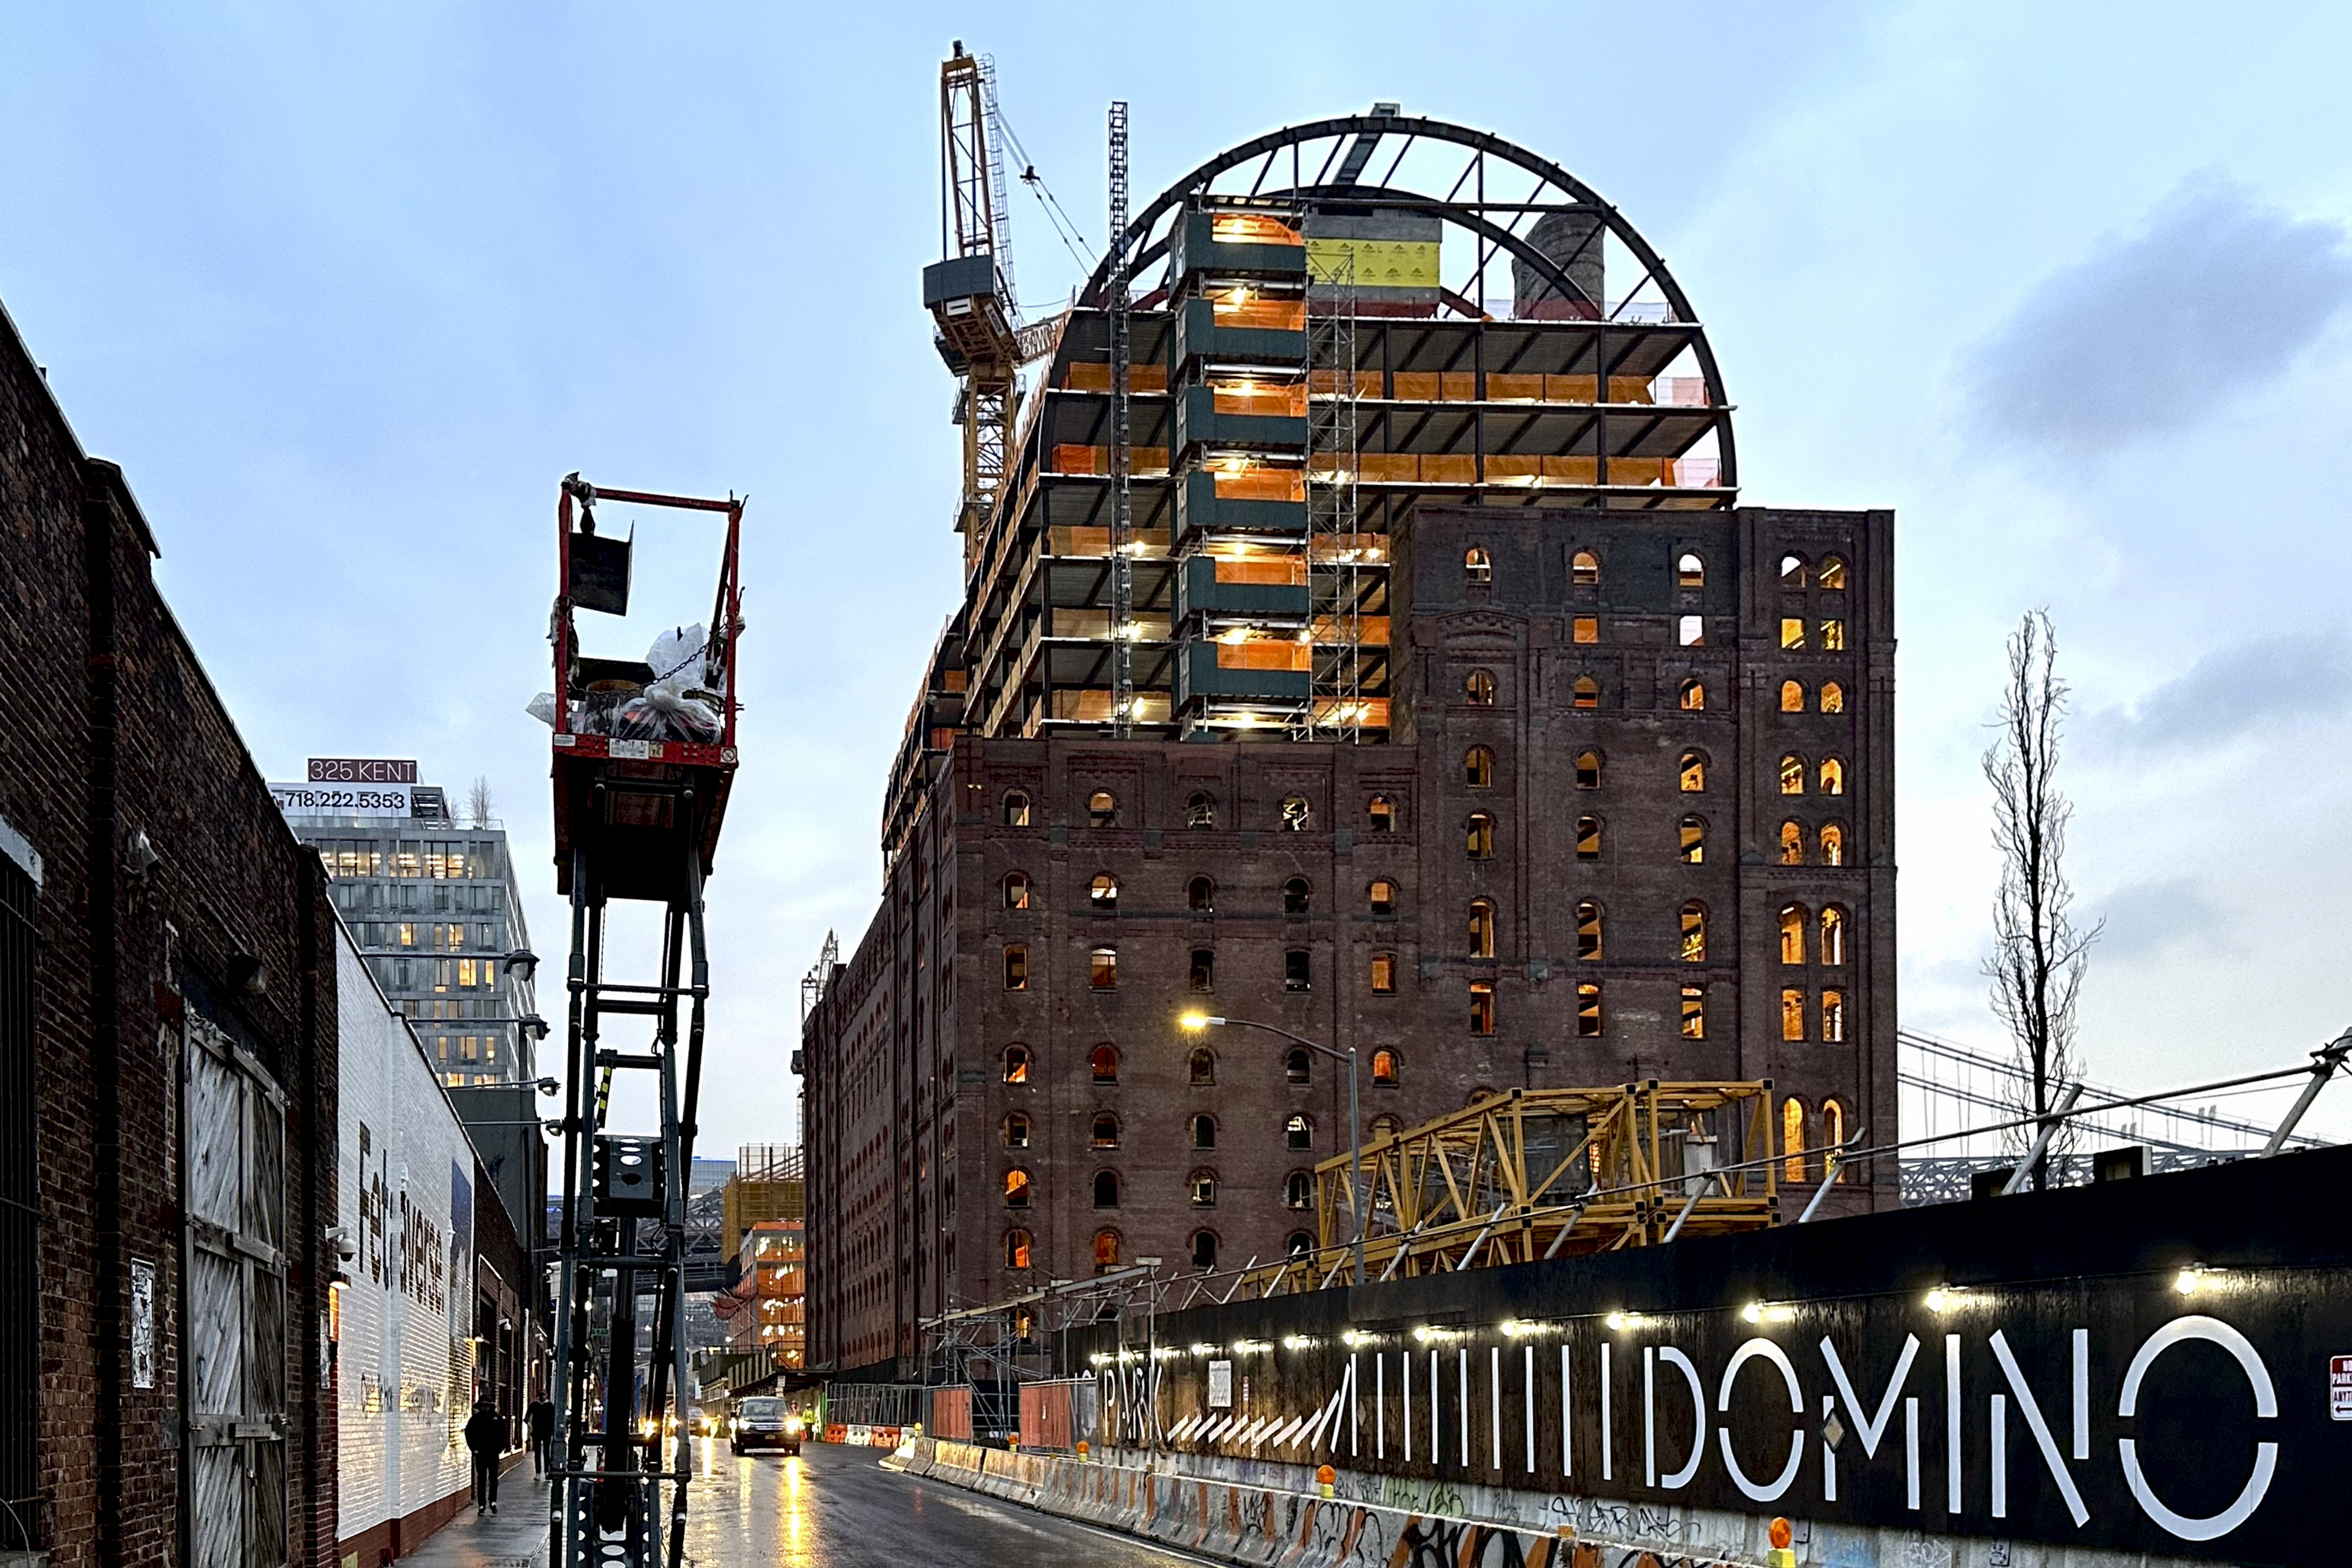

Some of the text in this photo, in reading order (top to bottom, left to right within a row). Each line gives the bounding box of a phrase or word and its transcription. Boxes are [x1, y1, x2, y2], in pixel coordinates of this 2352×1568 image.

[310, 760, 415, 781] 325 KENT
[285, 793, 405, 809] 718.222.5353
[1643, 1315, 2278, 1542] DOMINO
